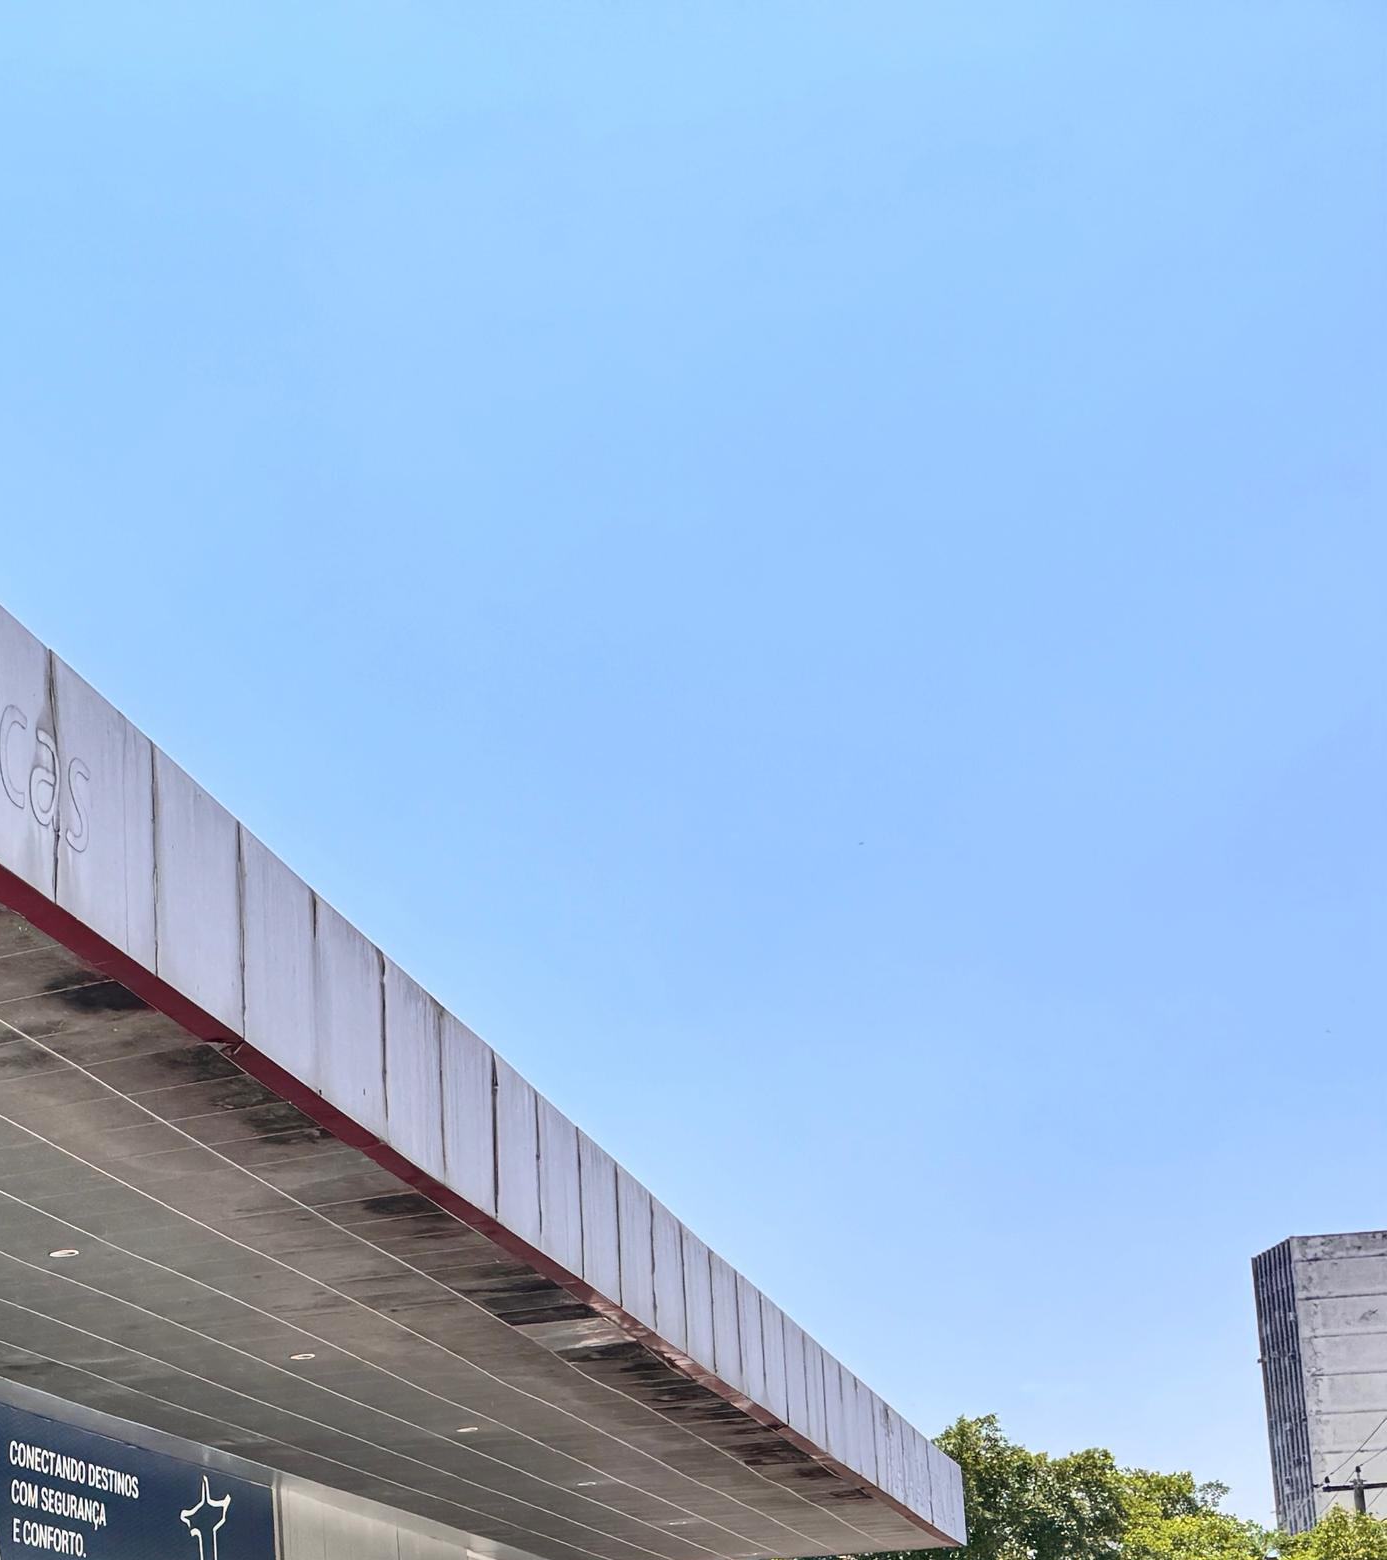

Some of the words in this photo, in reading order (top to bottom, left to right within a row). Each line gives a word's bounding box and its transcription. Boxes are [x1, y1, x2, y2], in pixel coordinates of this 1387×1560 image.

[10, 1440, 86, 1484] CONECTANDO
[88, 1464, 139, 1499] DESTINOS
[11, 1480, 38, 1509] COM
[41, 1487, 106, 1531] SEGURANÇA
[13, 1518, 21, 1543] E
[23, 1521, 87, 1558] CONFORTO.
